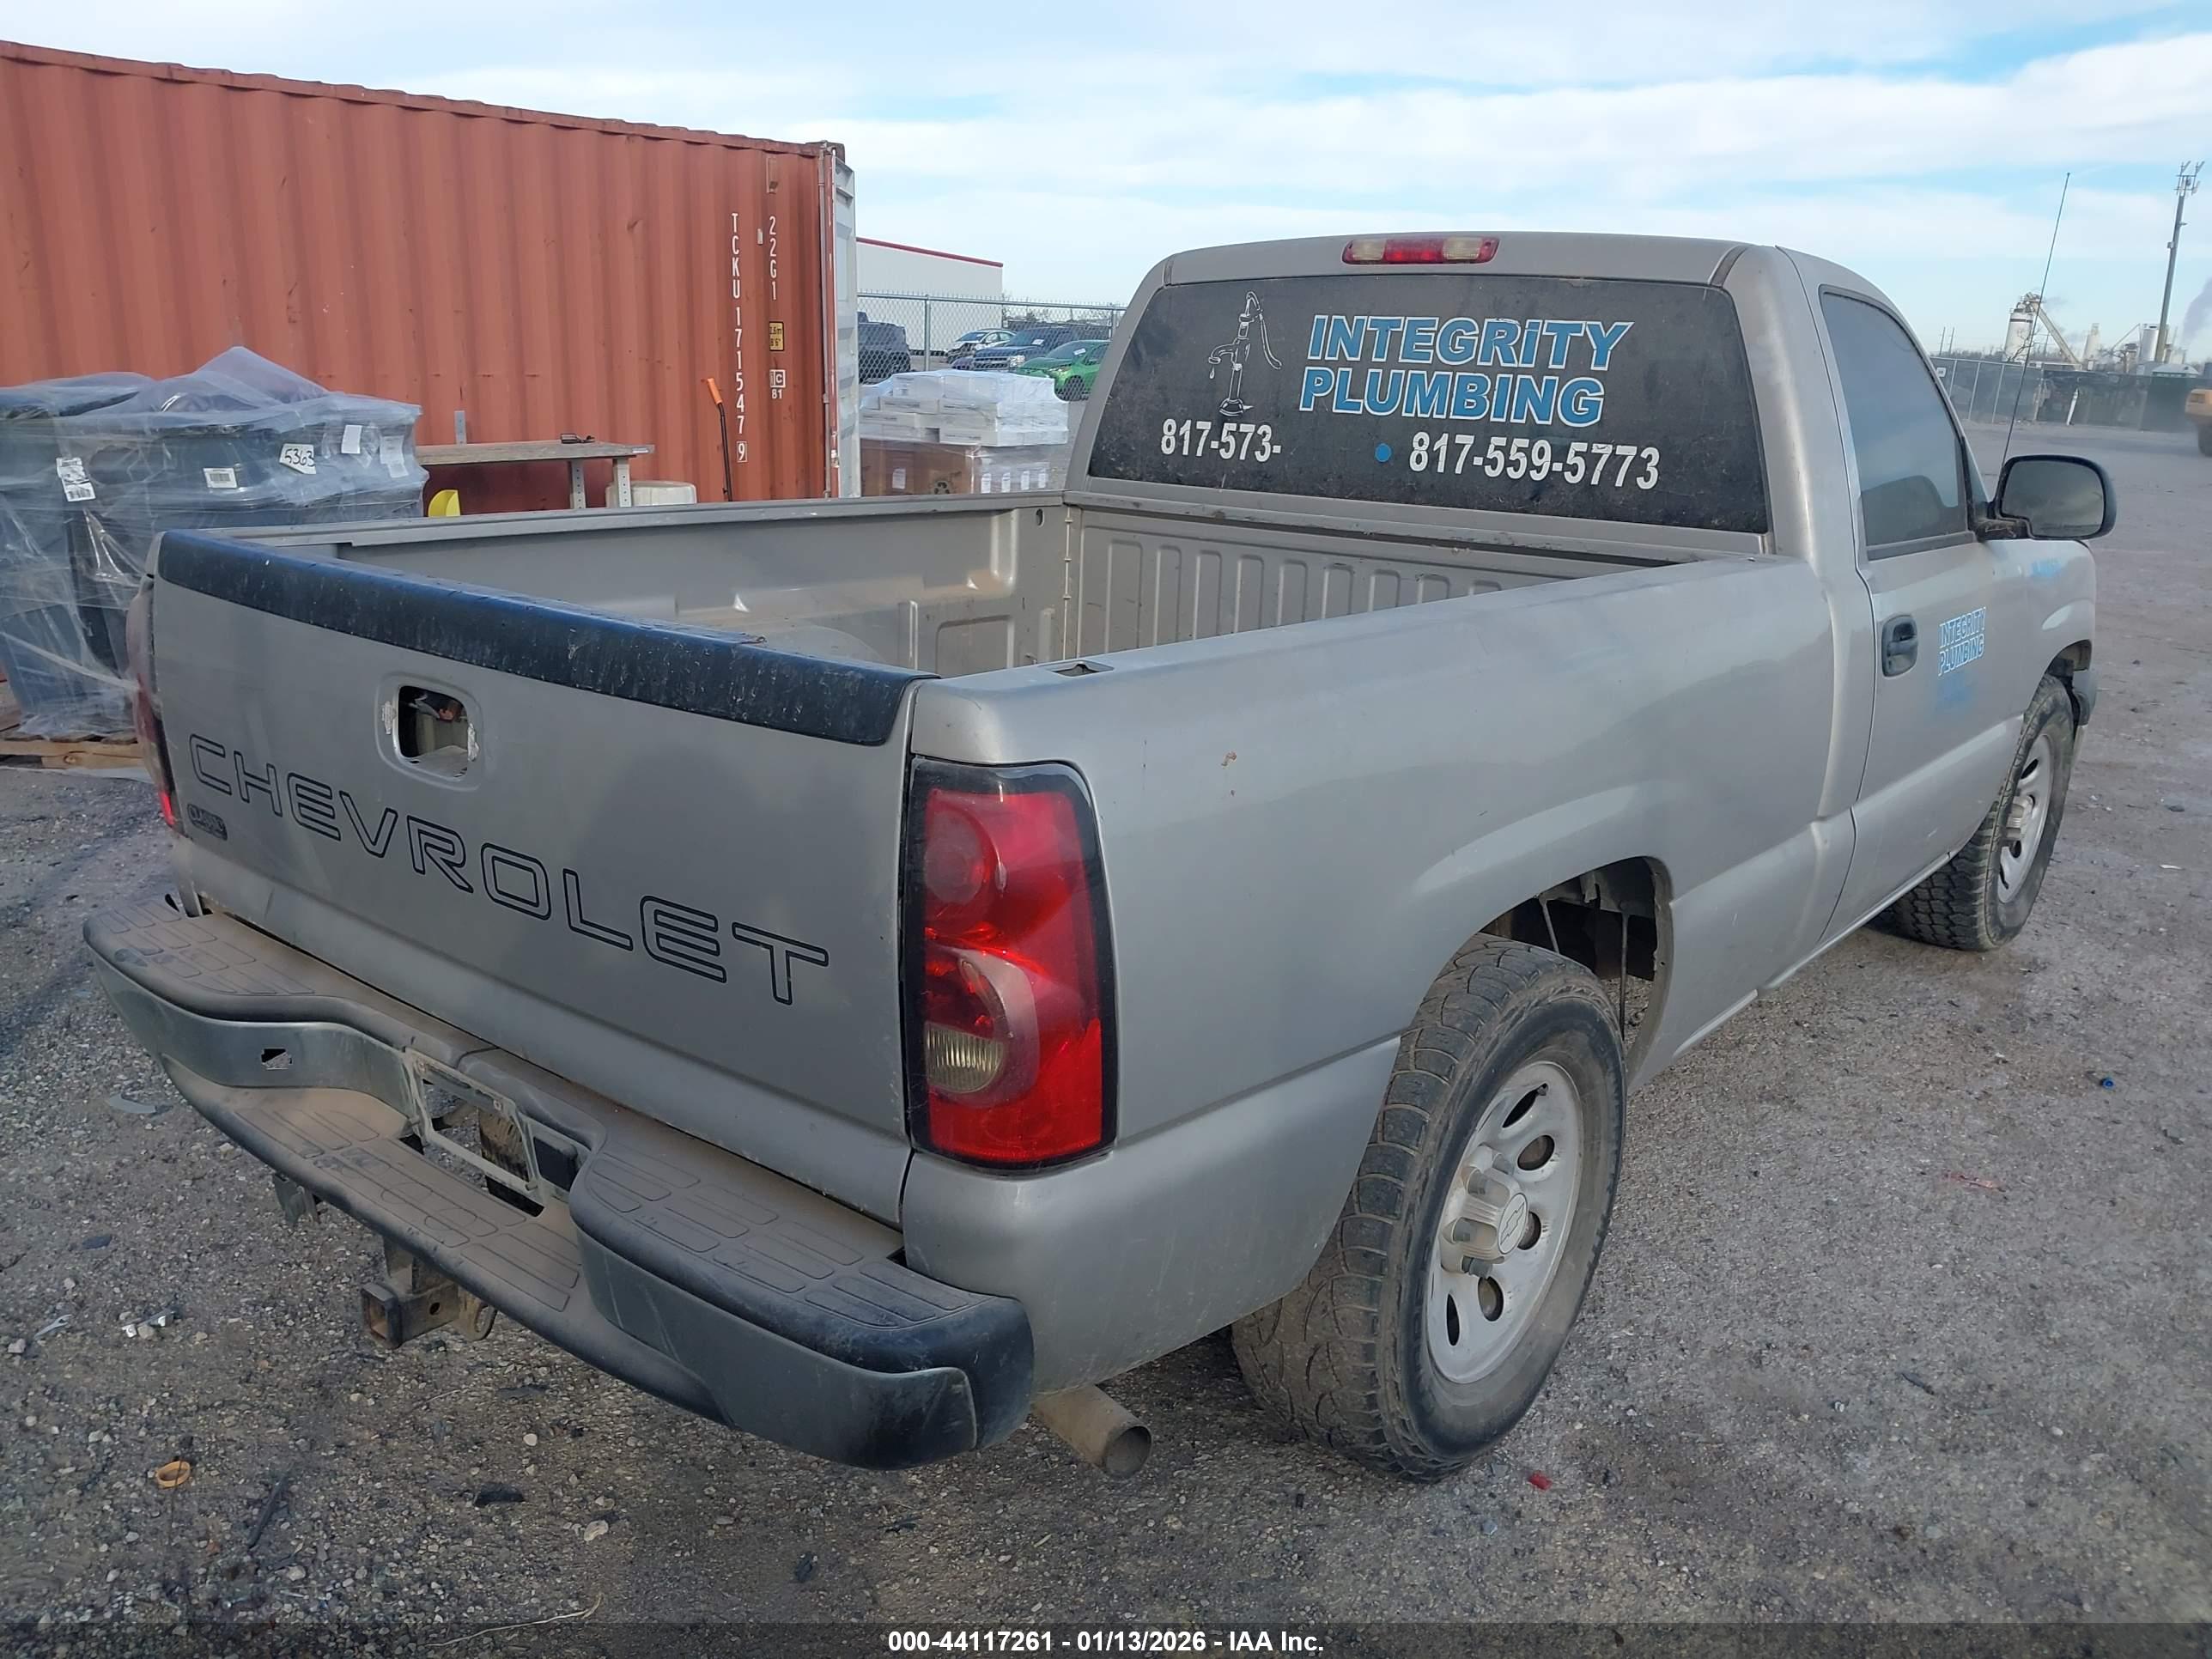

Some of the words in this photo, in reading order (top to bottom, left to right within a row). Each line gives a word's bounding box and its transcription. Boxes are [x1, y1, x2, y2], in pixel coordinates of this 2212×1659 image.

[731, 212, 740, 299] TCKU
[769, 215, 777, 301] 22G1
[734, 306, 744, 434] 171547
[1306, 314, 1635, 371] INTEGRITY
[1298, 366, 1605, 428] PLUMBING
[284, 447, 316, 467] 5363
[738, 441, 746, 461] 9
[1160, 418, 1282, 462] 817-573-
[1409, 431, 1660, 489] 817-559-5773
[1937, 633, 1985, 676] PLUMBING
[1938, 606, 1986, 649] INTEGRITY
[188, 732, 830, 1006] CHEVROLET
